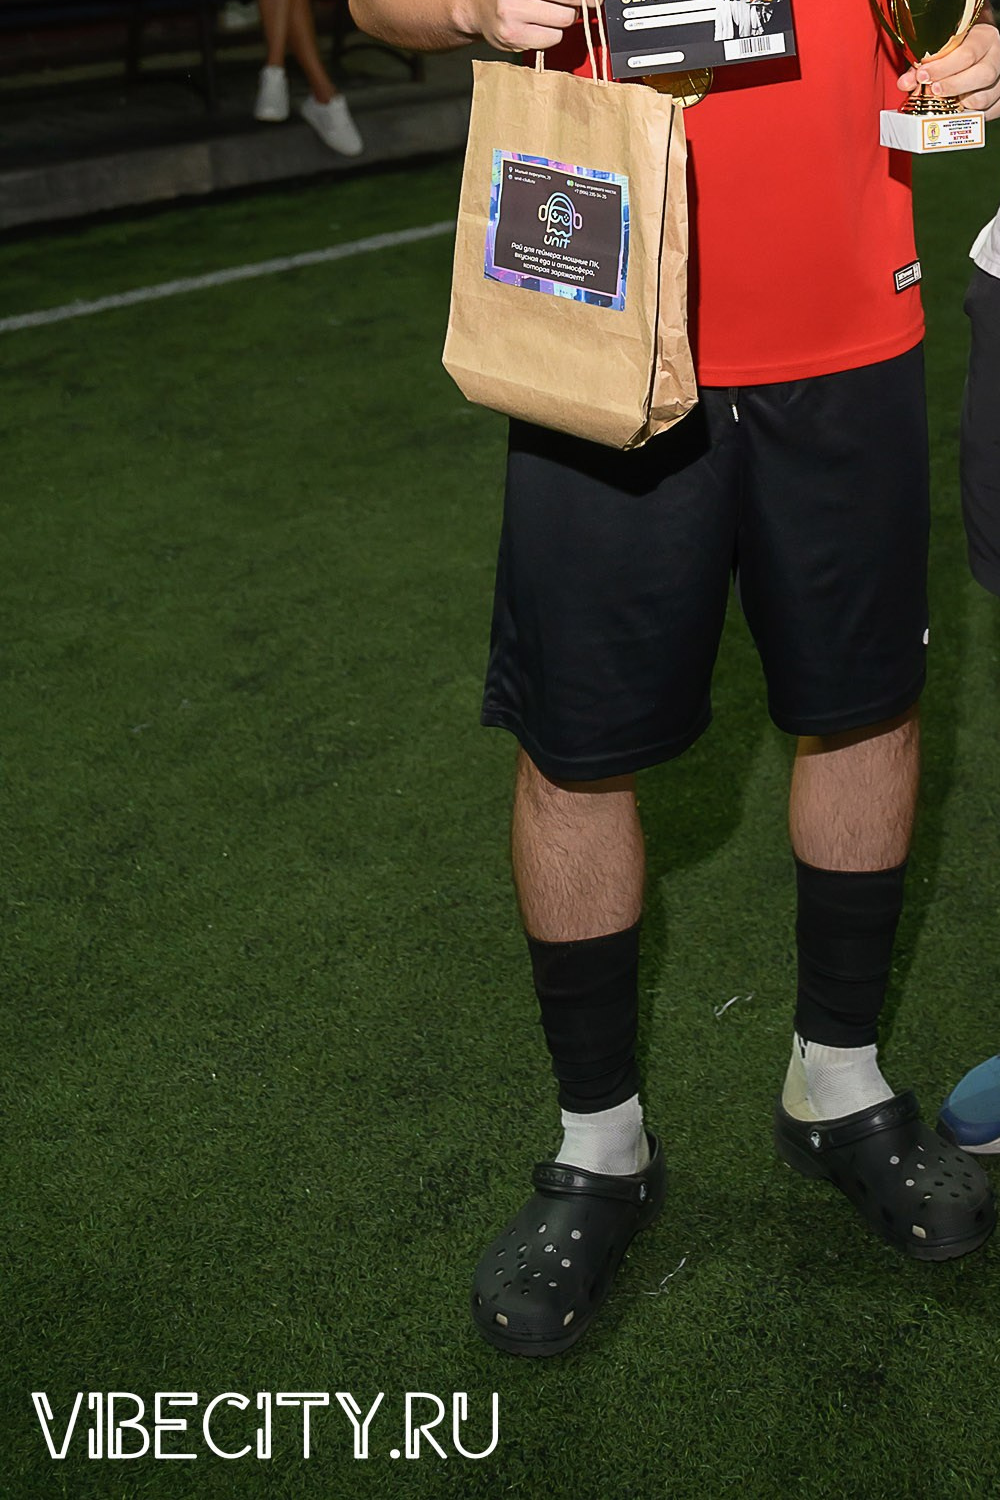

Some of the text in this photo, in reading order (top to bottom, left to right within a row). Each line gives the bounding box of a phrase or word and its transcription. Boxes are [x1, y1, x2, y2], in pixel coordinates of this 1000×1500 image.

[539, 258, 551, 266] еда
[562, 255, 588, 266] мощные
[523, 263, 550, 274] которая
